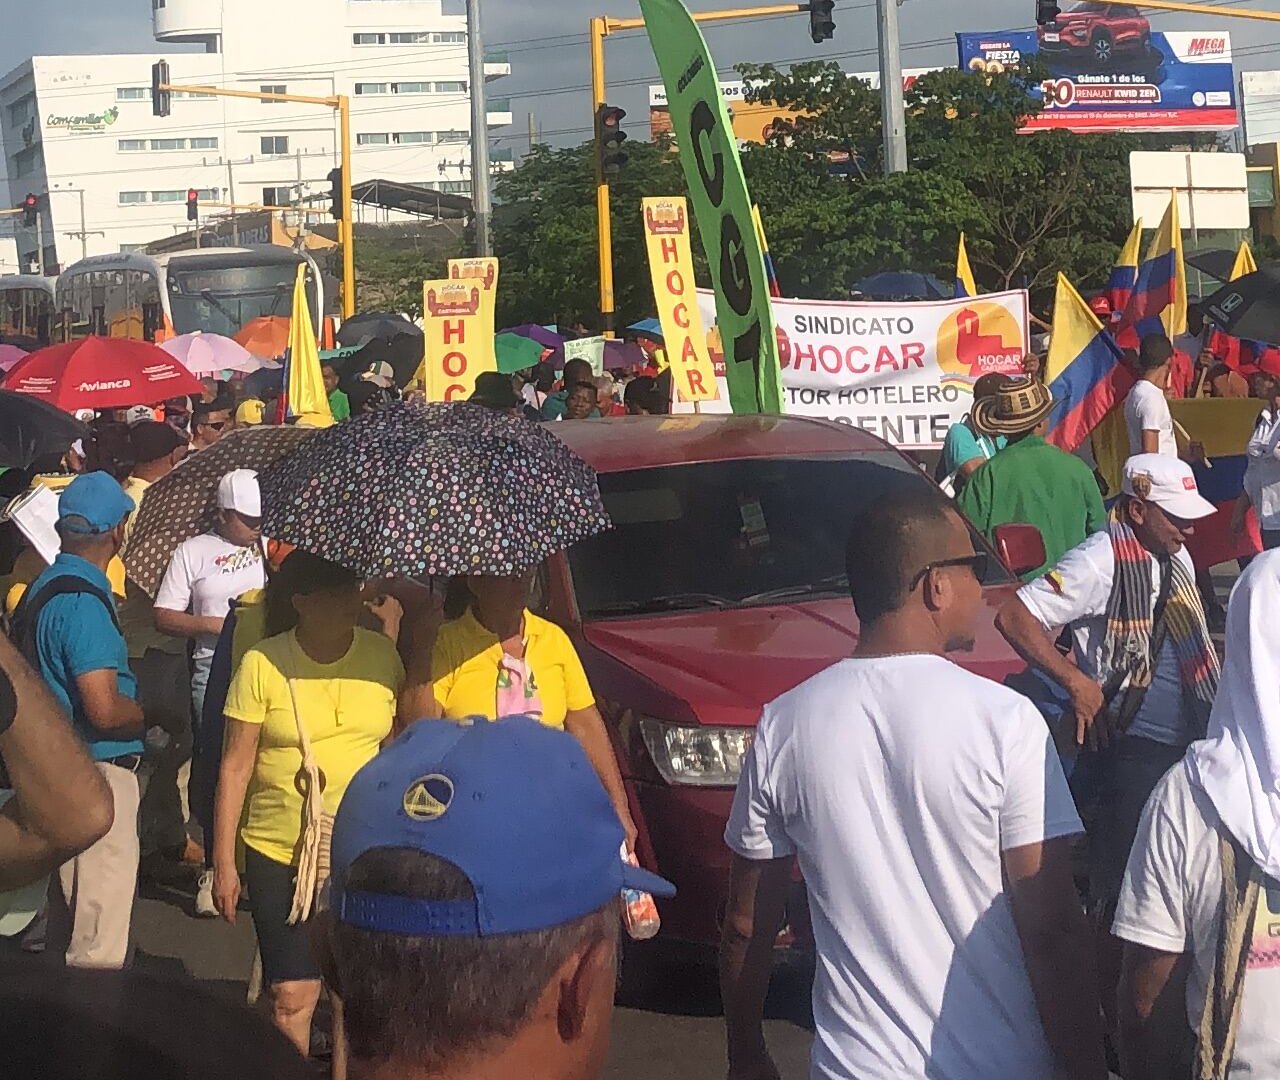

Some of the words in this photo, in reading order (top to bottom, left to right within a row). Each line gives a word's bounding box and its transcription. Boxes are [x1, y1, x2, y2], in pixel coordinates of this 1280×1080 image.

[1191, 38, 1225, 50] MEGA
[985, 50, 1020, 60] FIESTA
[1077, 73, 1110, 83] Gánate
[1112, 74, 1117, 83] 1
[1119, 74, 1131, 83] de
[1132, 74, 1146, 83] los
[1076, 89, 1113, 98] RENAULT
[1115, 89, 1138, 98] KWID
[660, 237, 709, 395] HOCAR
[794, 314, 915, 336] SINDICATO
[792, 341, 927, 375] HOCAR
[977, 353, 1022, 366] HOCAR
[79, 378, 131, 392] Avianca
[783, 386, 831, 405] TOR
[838, 384, 959, 405] HOTELERO
[815, 414, 950, 444] ENTE
